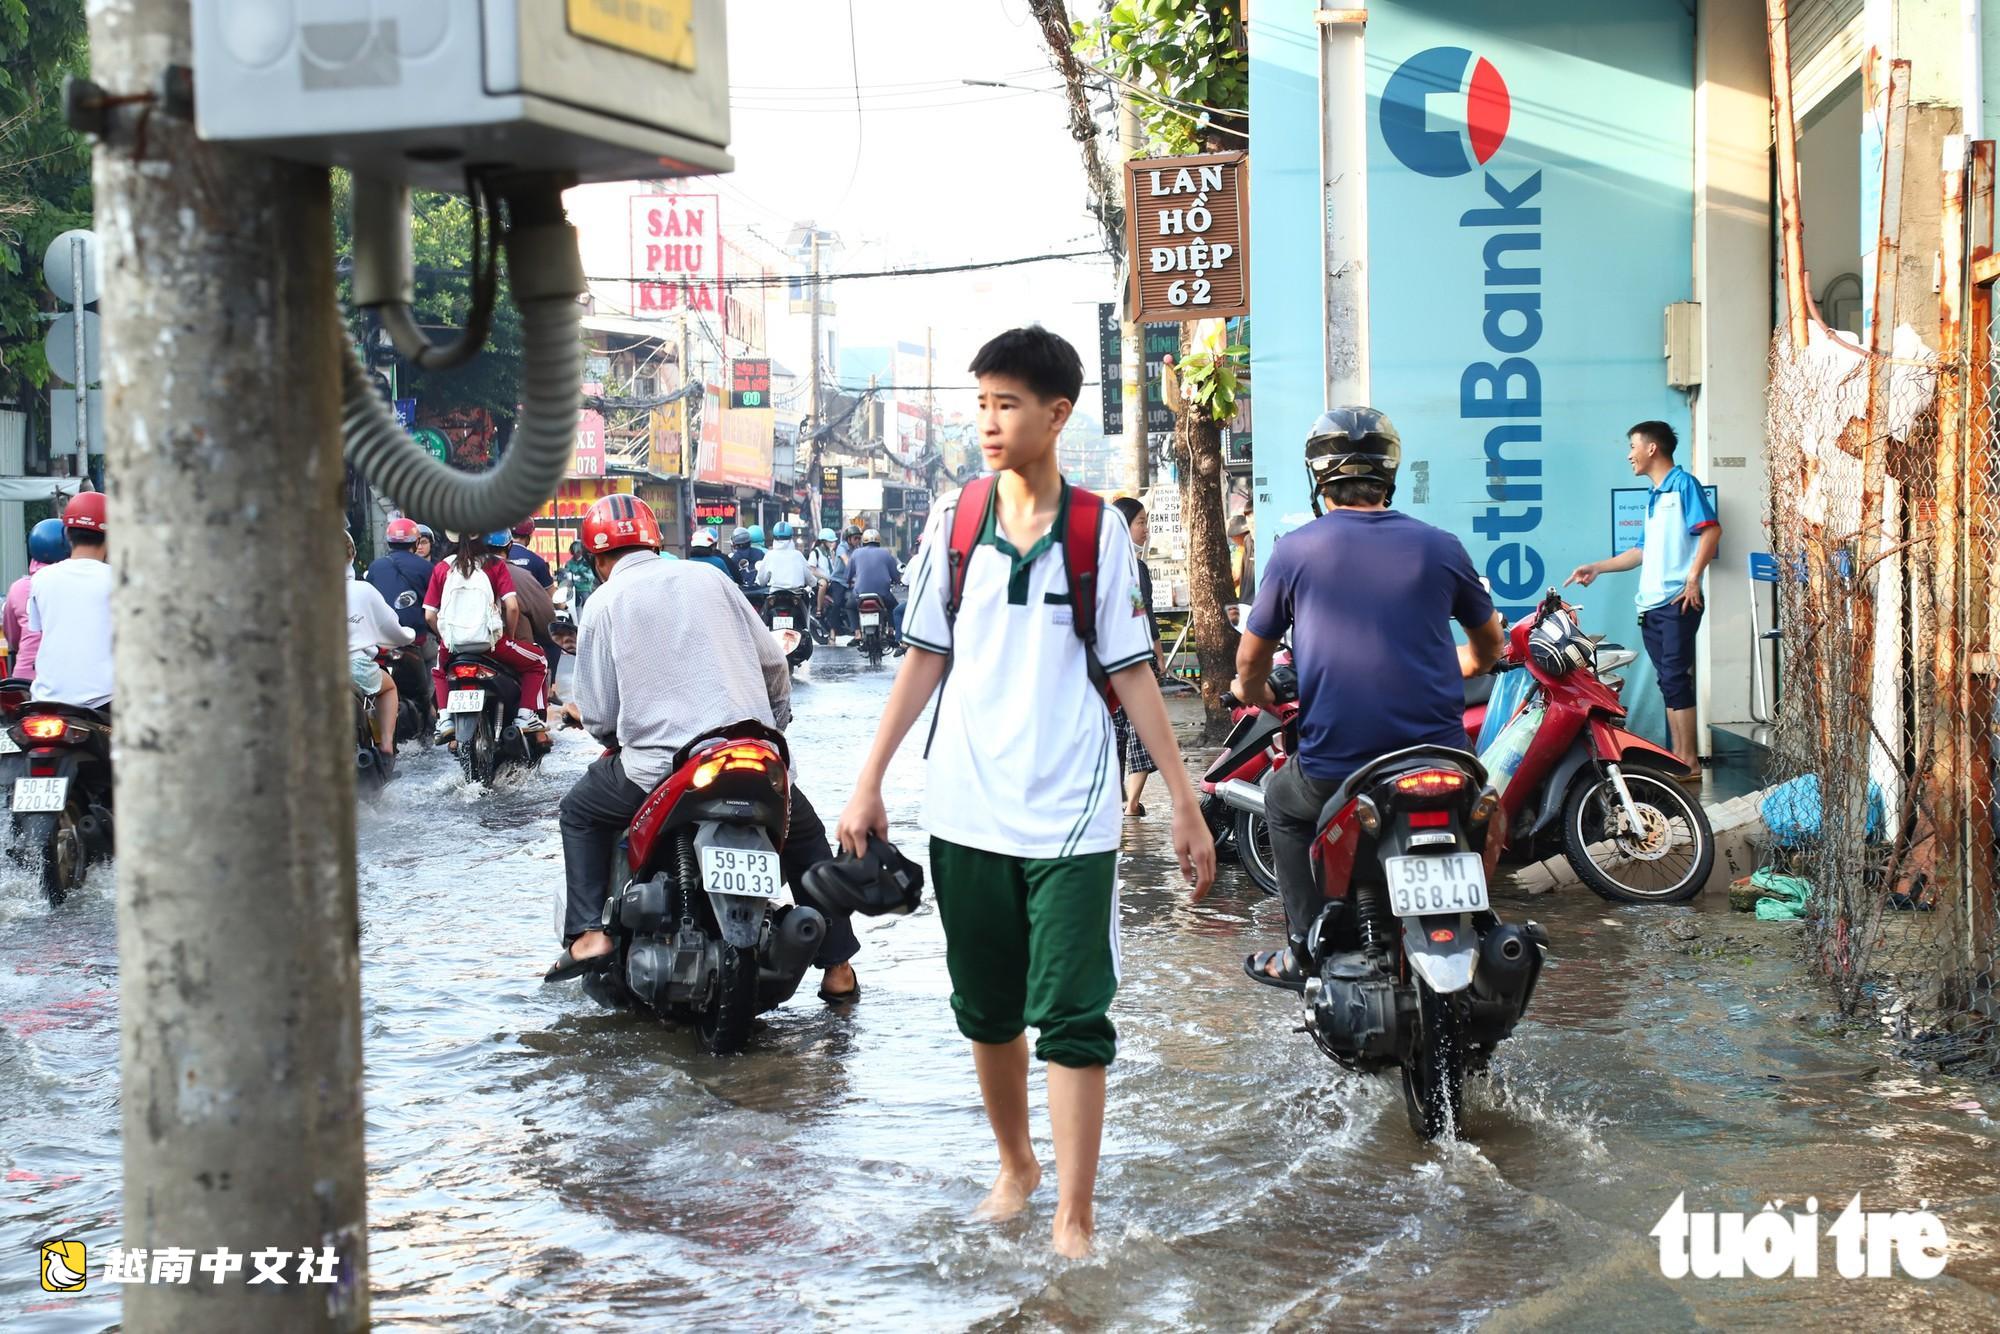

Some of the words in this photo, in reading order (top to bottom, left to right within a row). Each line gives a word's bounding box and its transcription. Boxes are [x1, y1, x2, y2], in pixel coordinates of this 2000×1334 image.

[1149, 165, 1223, 196] LAN
[648, 197, 704, 237] SẢN
[1158, 192, 1212, 235] HỒ
[646, 244, 703, 279] PHỤ
[1150, 236, 1233, 278] ĐIỆP
[1167, 279, 1211, 306] 62
[577, 431, 596, 449] XE
[23, 780, 59, 793] 50-AE
[715, 851, 768, 872] 59-P3
[1402, 857, 1467, 884] 59-N1
[711, 871, 774, 895] 200.33
[1397, 883, 1481, 912] 368.40
